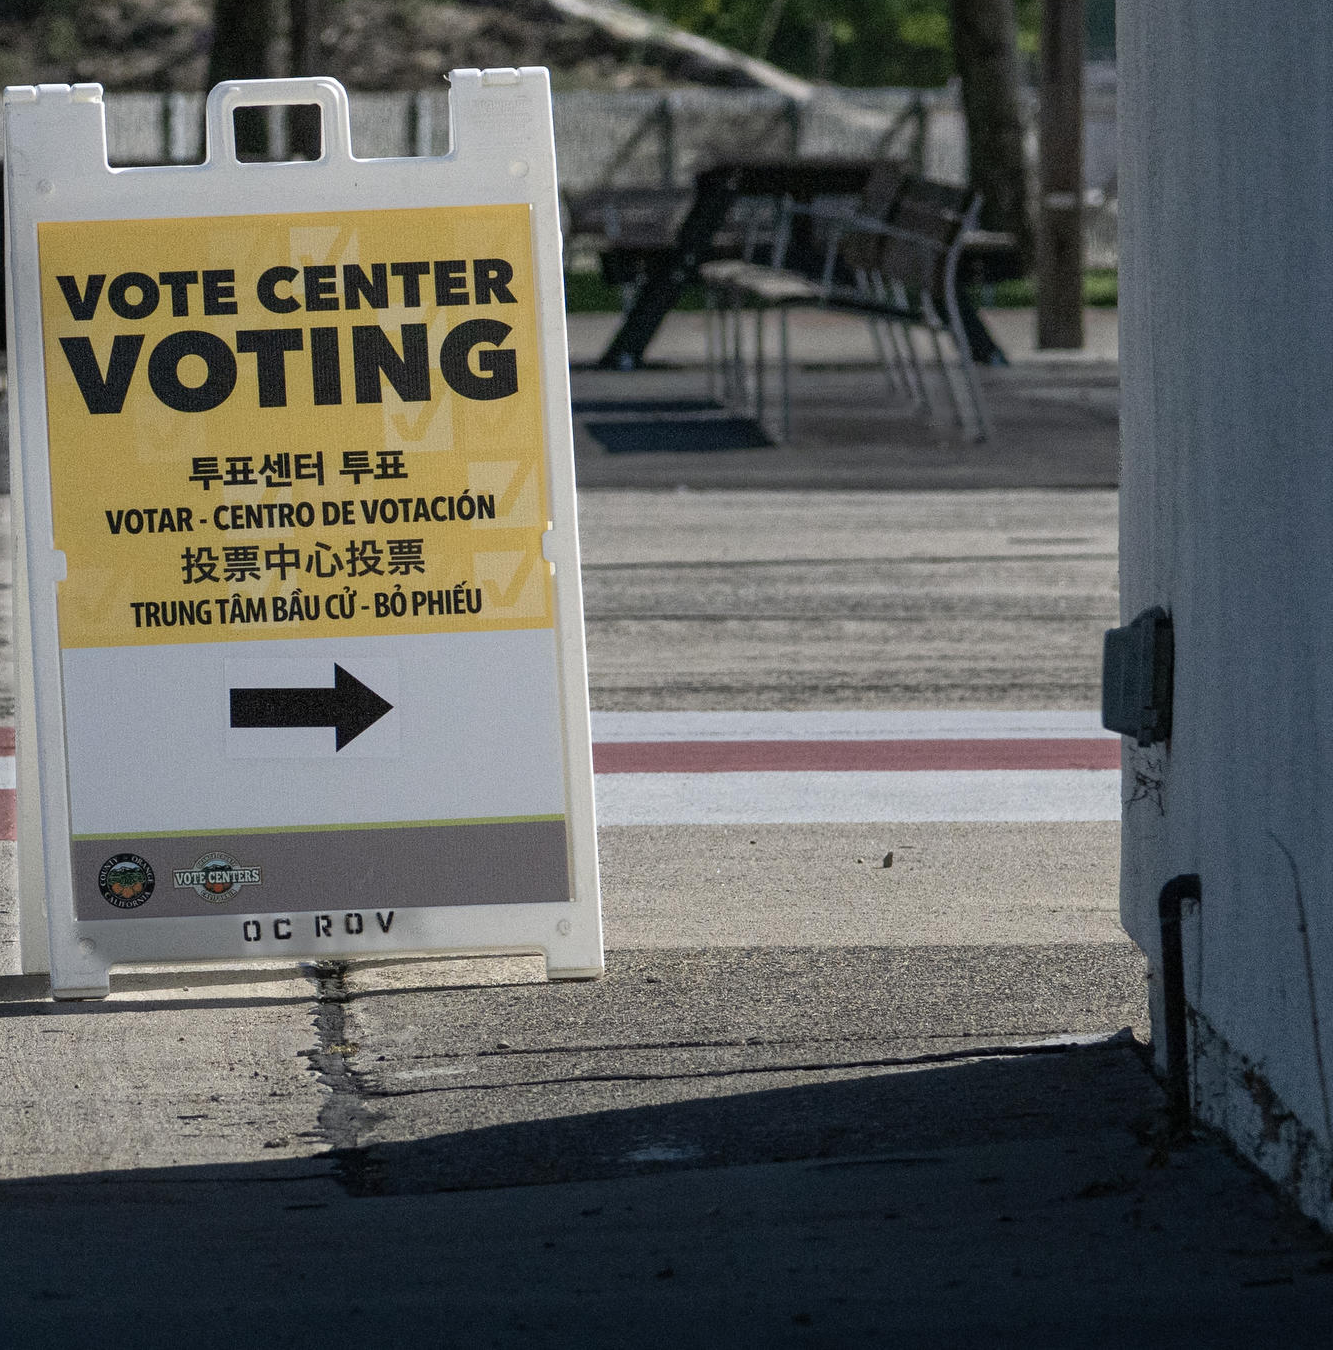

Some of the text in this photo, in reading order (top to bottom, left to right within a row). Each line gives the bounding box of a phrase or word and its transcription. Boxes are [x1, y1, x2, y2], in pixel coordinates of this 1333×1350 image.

[56, 259, 517, 321] VOTE CENTER
[59, 318, 519, 414] VOTING
[189, 450, 408, 490] 투표센터 투표
[105, 507, 193, 534] VOTAR
[214, 502, 314, 531] CENTRO
[322, 499, 355, 527] DE
[362, 489, 495, 524] VOTACIÓN
[181, 539, 425, 584] 投票中心投票
[130, 600, 212, 627] TRUNG
[215, 593, 267, 624] TÂM
[272, 588, 320, 622] BẦU
[325, 586, 357, 620] CỬ
[374, 584, 407, 617] BỎ
[412, 580, 482, 616] PHIẾU
[100, 858, 118, 886] COUNTY
[175, 870, 260, 885] VOTE CENTERS
[104, 891, 151, 908] CALIFORNIA
[243, 911, 394, 942] OC ROV
